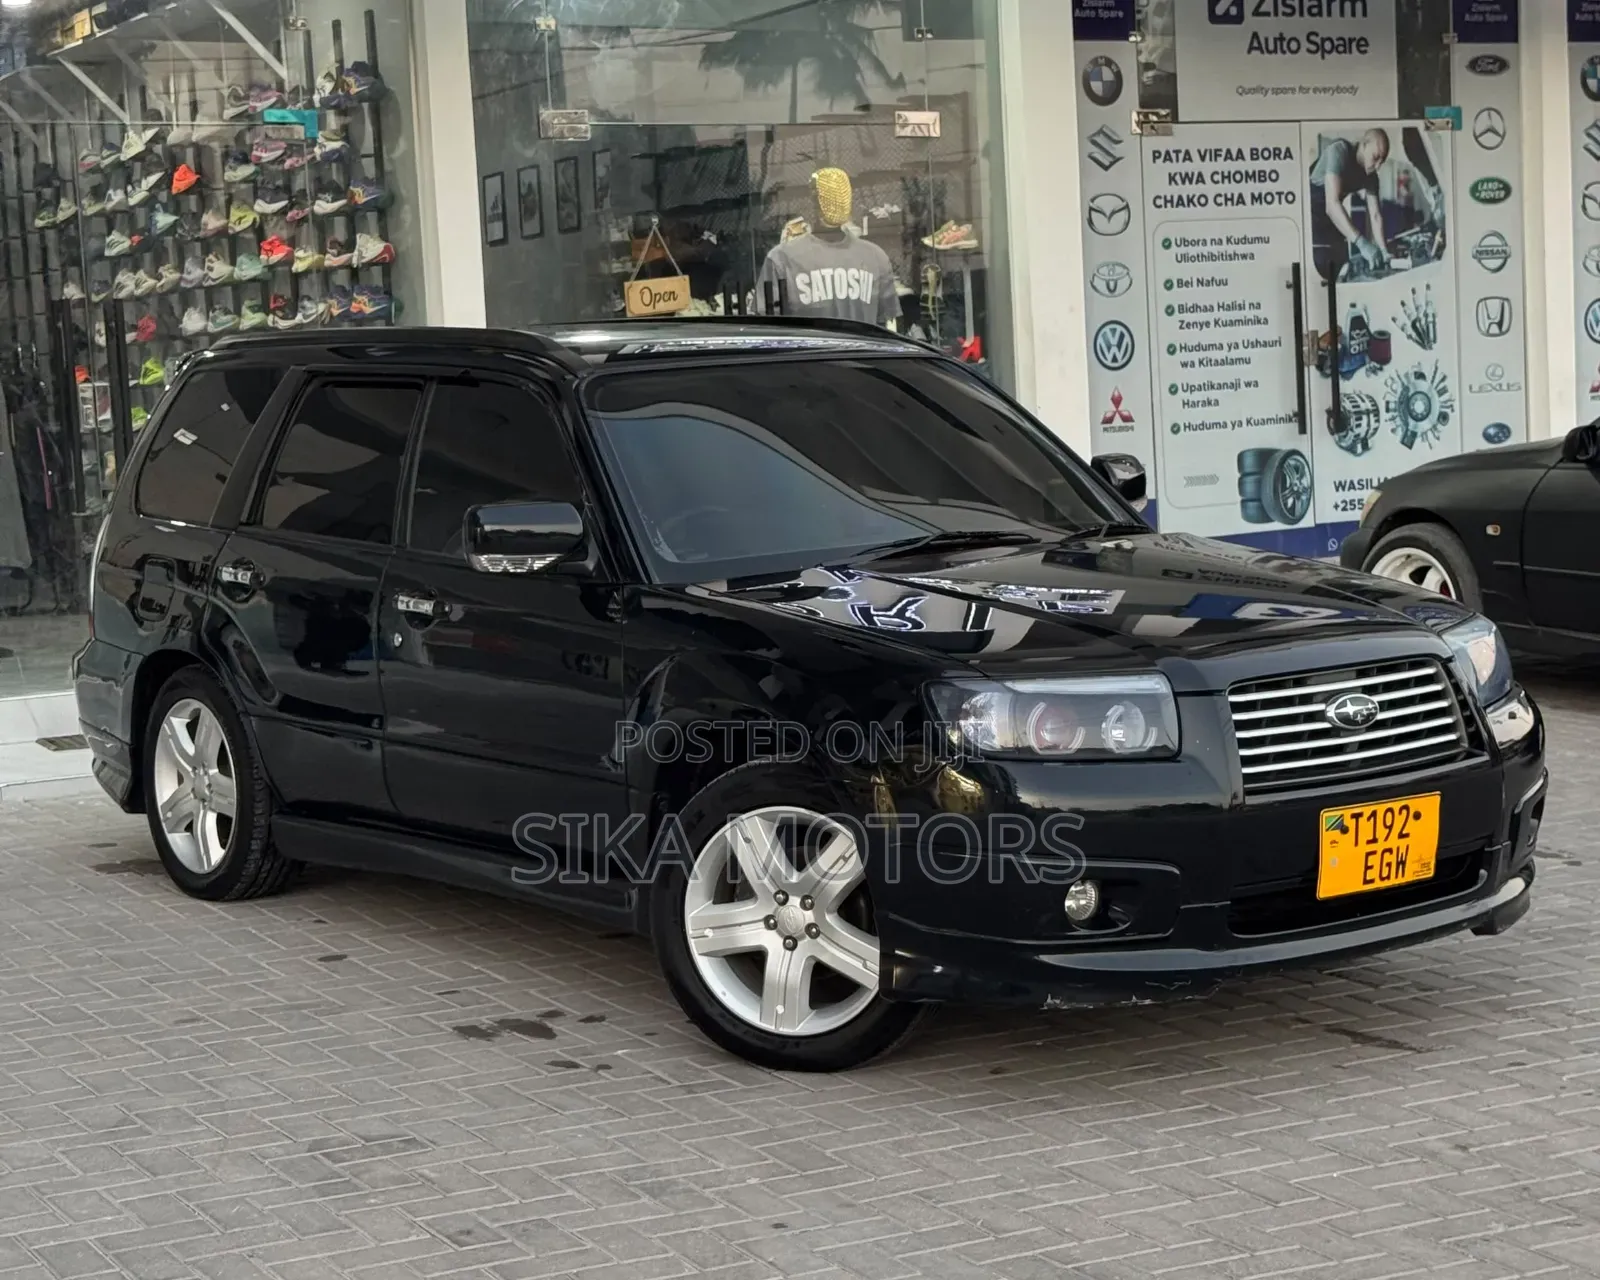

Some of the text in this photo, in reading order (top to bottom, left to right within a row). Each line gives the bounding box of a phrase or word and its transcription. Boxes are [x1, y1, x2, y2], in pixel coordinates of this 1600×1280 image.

[1247, 31, 1370, 60] Auto Spare
[1236, 84, 1359, 97] Quality spare for everybody
[1152, 146, 1294, 164] PATA VIFAA BORA
[1168, 169, 1280, 186] KWA CHOMBO
[1153, 191, 1296, 209] CHAKO CHA MOTO
[1174, 234, 1270, 248] Ubora na Kudumu
[1175, 250, 1255, 263] Uliothibitishwa
[796, 267, 874, 305] SATOSHI
[1176, 276, 1229, 289] Bei Nafuu
[639, 286, 678, 309] Open
[1177, 300, 1261, 315] Bidhaa Halisi na
[1178, 315, 1269, 331] Zenye Kuaminika
[1179, 336, 1282, 354] Huduma ya Ushauri
[1180, 355, 1252, 369] wa Kitaalamu
[1181, 378, 1260, 394] Upatikanaji wa
[1469, 382, 1522, 394] LEXUS
[1182, 397, 1220, 409] Haraka
[1183, 419, 1228, 432] Huduma
[1230, 419, 1244, 430] ya
[1350, 804, 1410, 847] T192
[1362, 844, 1410, 885] EGW
